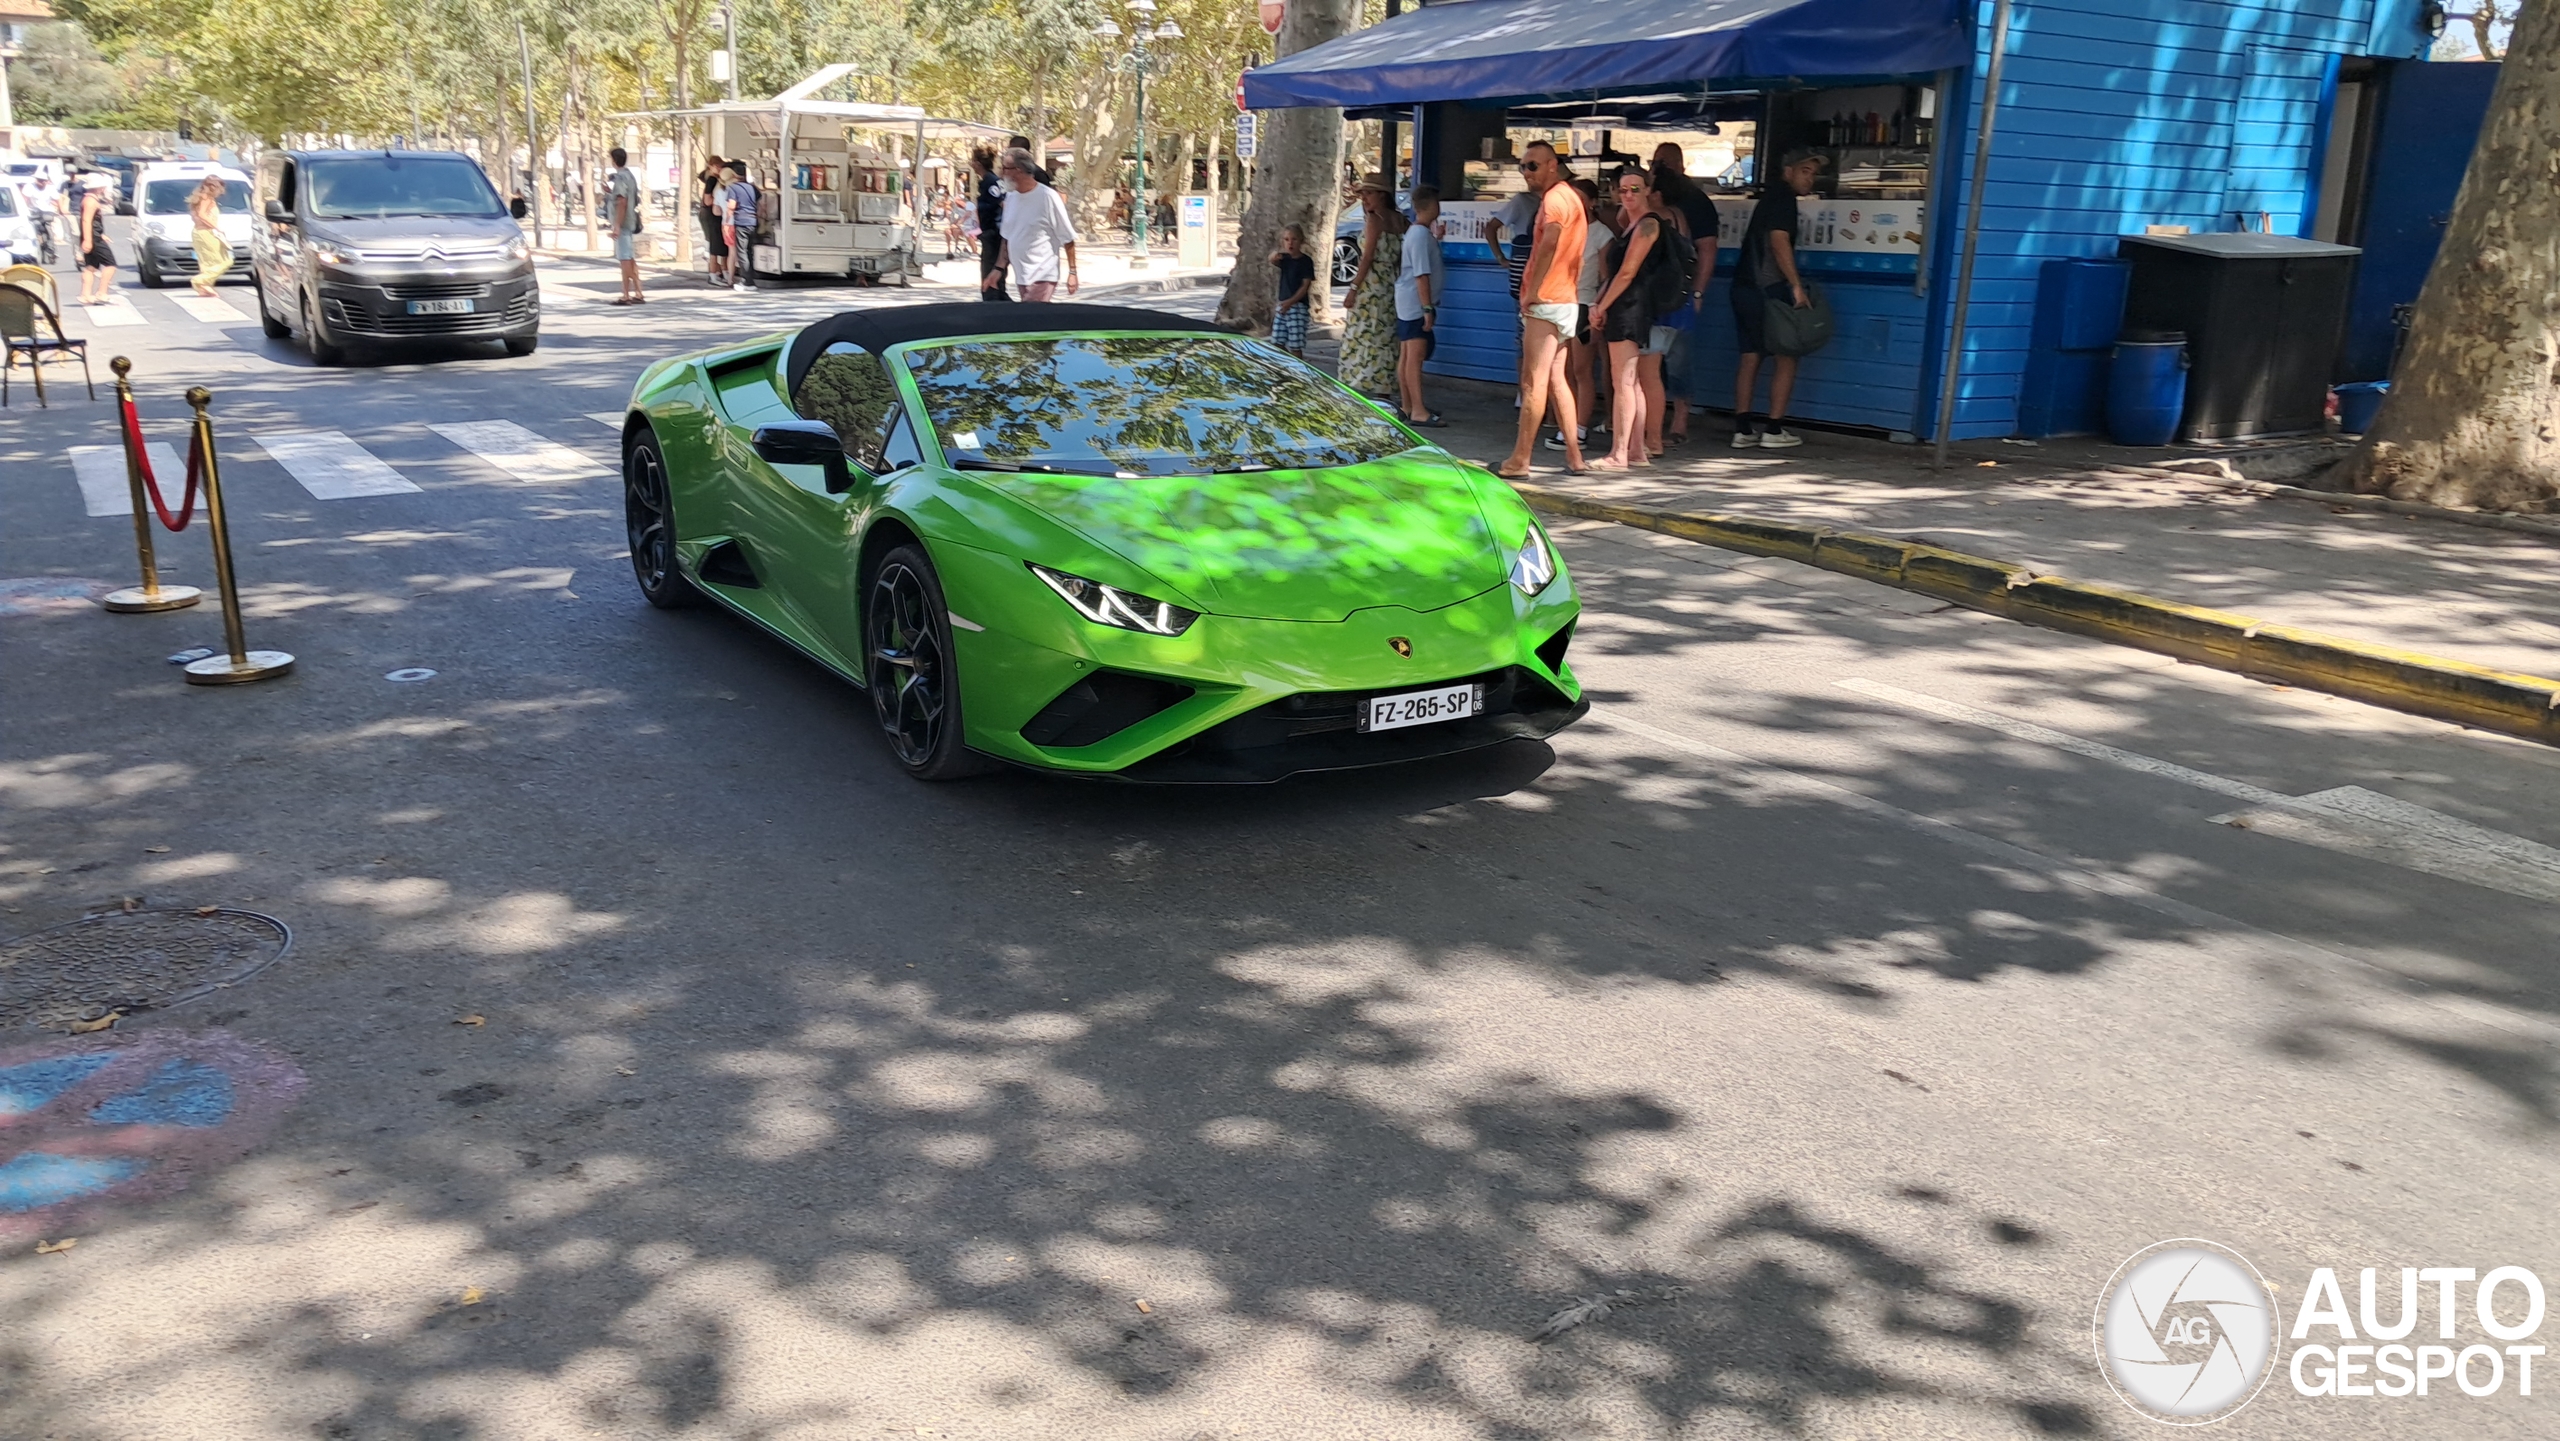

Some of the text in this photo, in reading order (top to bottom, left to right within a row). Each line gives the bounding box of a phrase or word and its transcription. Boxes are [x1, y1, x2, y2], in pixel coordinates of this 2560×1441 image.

[1361, 718, 1367, 726] F
[1375, 692, 1468, 724] FZ-265-SP
[1473, 700, 1483, 711] 06
